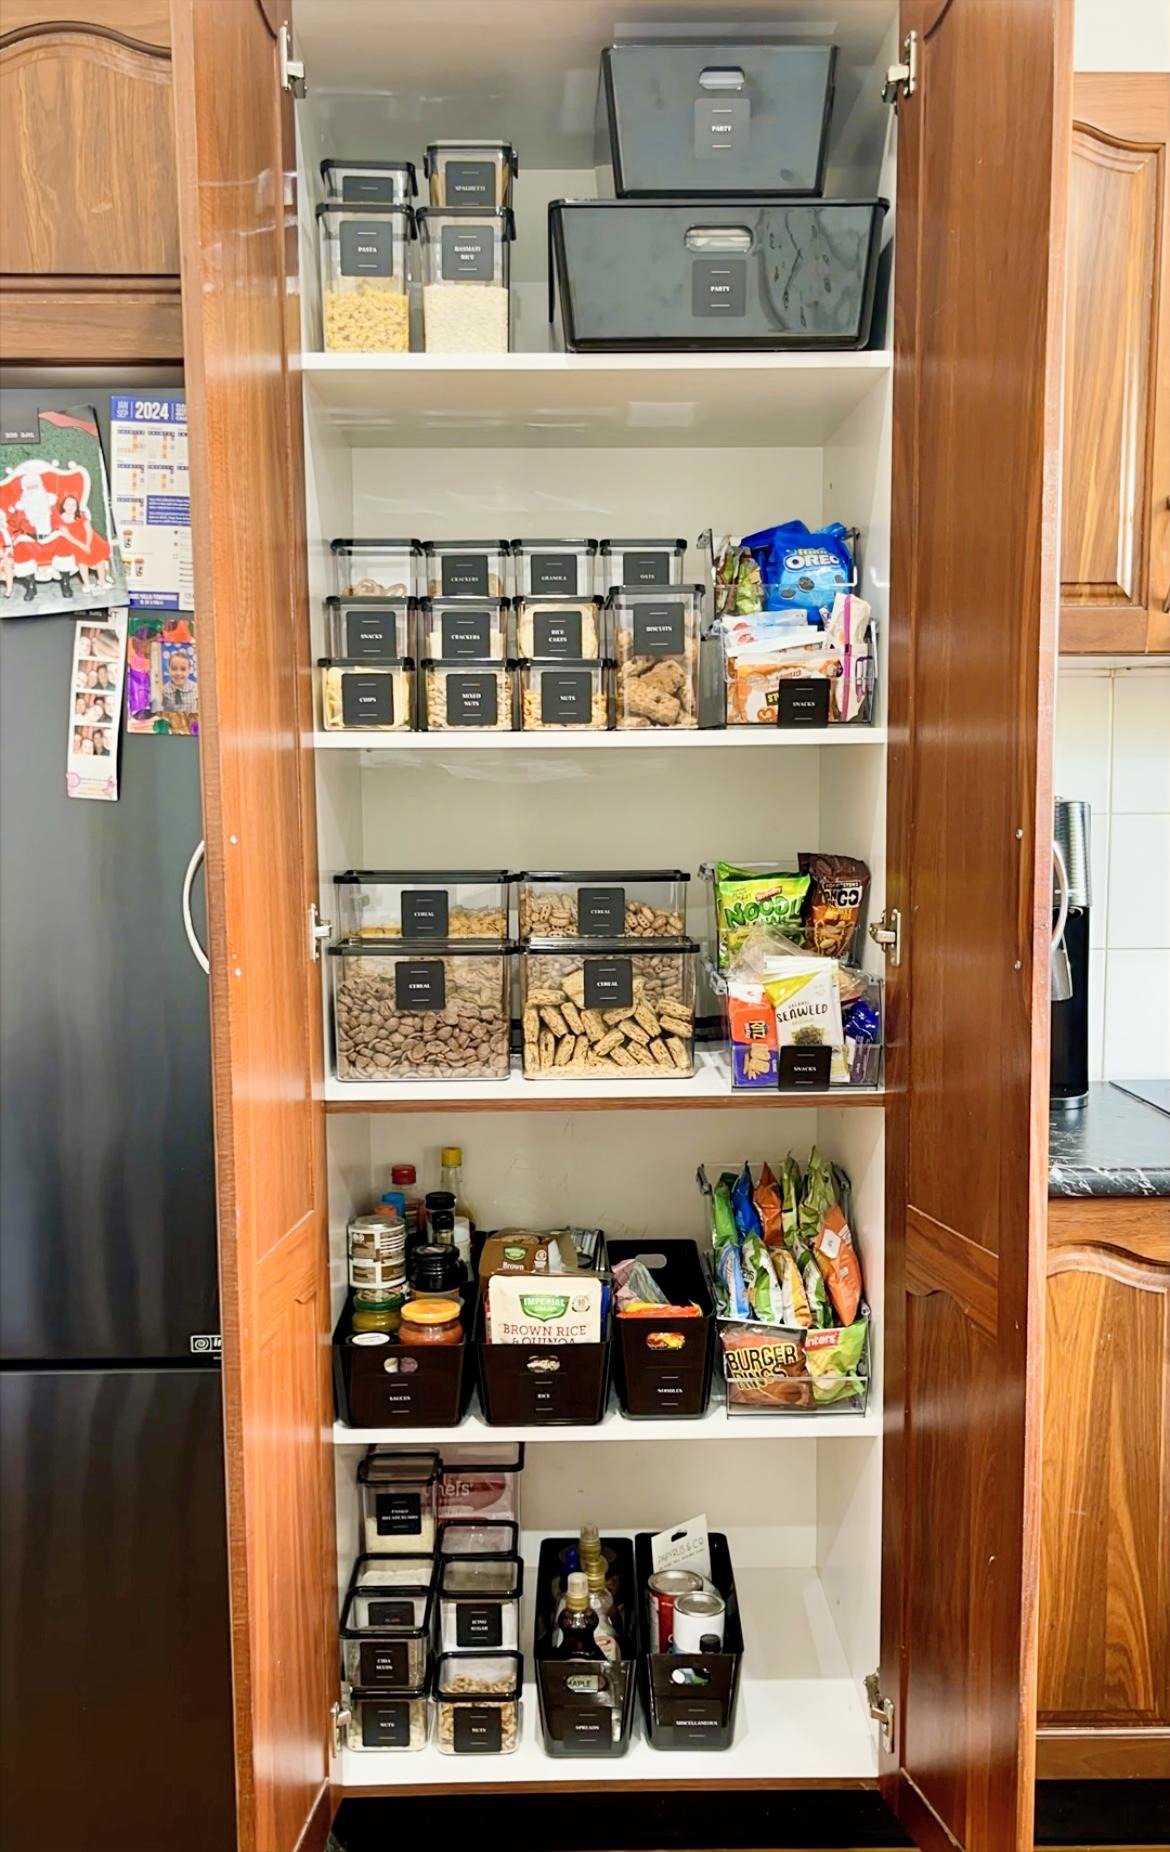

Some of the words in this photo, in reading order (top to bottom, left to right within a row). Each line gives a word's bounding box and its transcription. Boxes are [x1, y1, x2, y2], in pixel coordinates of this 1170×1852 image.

[134, 400, 169, 420] 2024
[783, 554, 841, 570] OREO
[776, 1003, 828, 1023] SEAWEED
[749, 1020, 766, 1040] RITZ
[502, 1261, 525, 1272] Brown
[523, 1297, 565, 1308] IMPERIAL
[503, 1323, 552, 1336] BROWN
[557, 1325, 587, 1337] RICE
[725, 1344, 798, 1372] BURGER
[734, 1363, 788, 1390] RINGS
